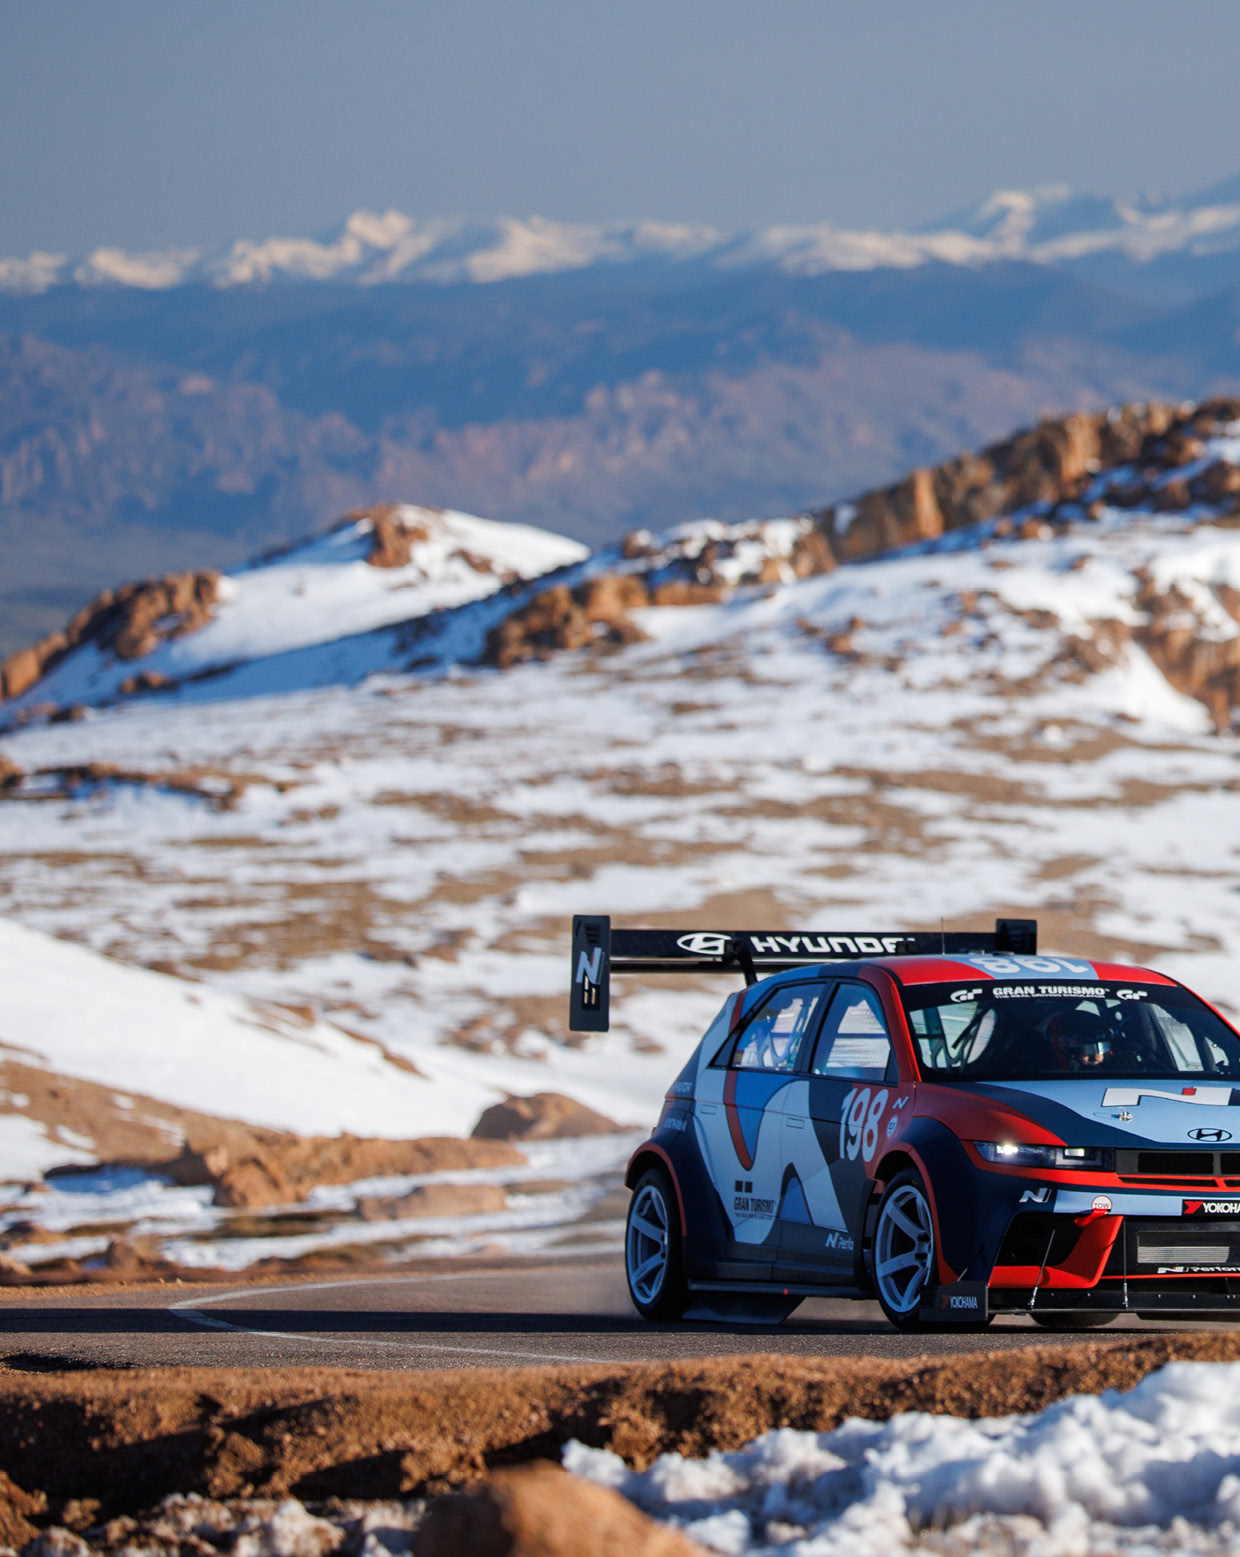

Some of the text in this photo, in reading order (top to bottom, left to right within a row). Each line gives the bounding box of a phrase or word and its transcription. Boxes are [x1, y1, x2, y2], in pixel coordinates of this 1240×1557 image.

[993, 985, 1106, 996] GRAN TURISMO
[839, 1087, 889, 1163] 198
[1094, 1202, 1110, 1210] TOW
